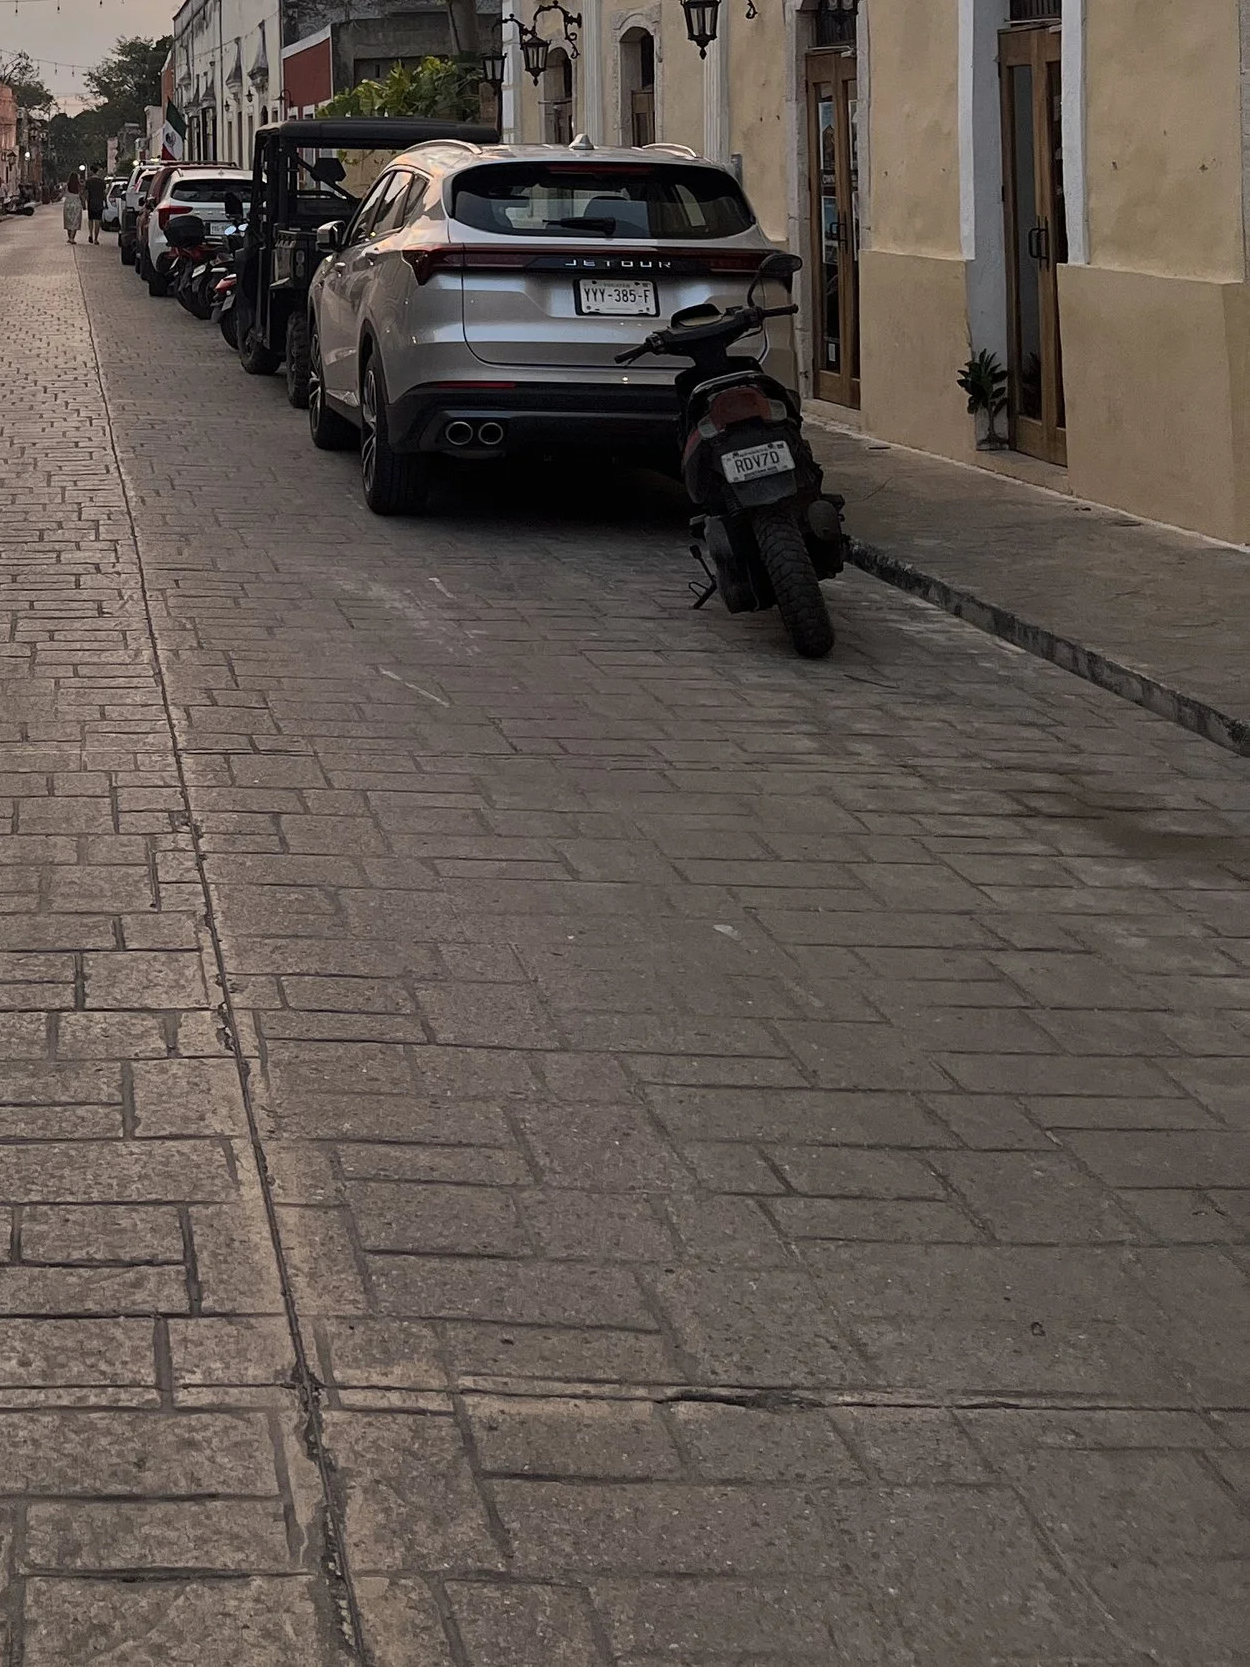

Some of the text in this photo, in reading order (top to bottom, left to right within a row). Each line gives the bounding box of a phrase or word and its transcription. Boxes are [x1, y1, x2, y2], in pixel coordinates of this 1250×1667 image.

[564, 258, 672, 269] JETOUR
[584, 288, 651, 303] YYY-385-F
[735, 451, 780, 474] RDV7D
